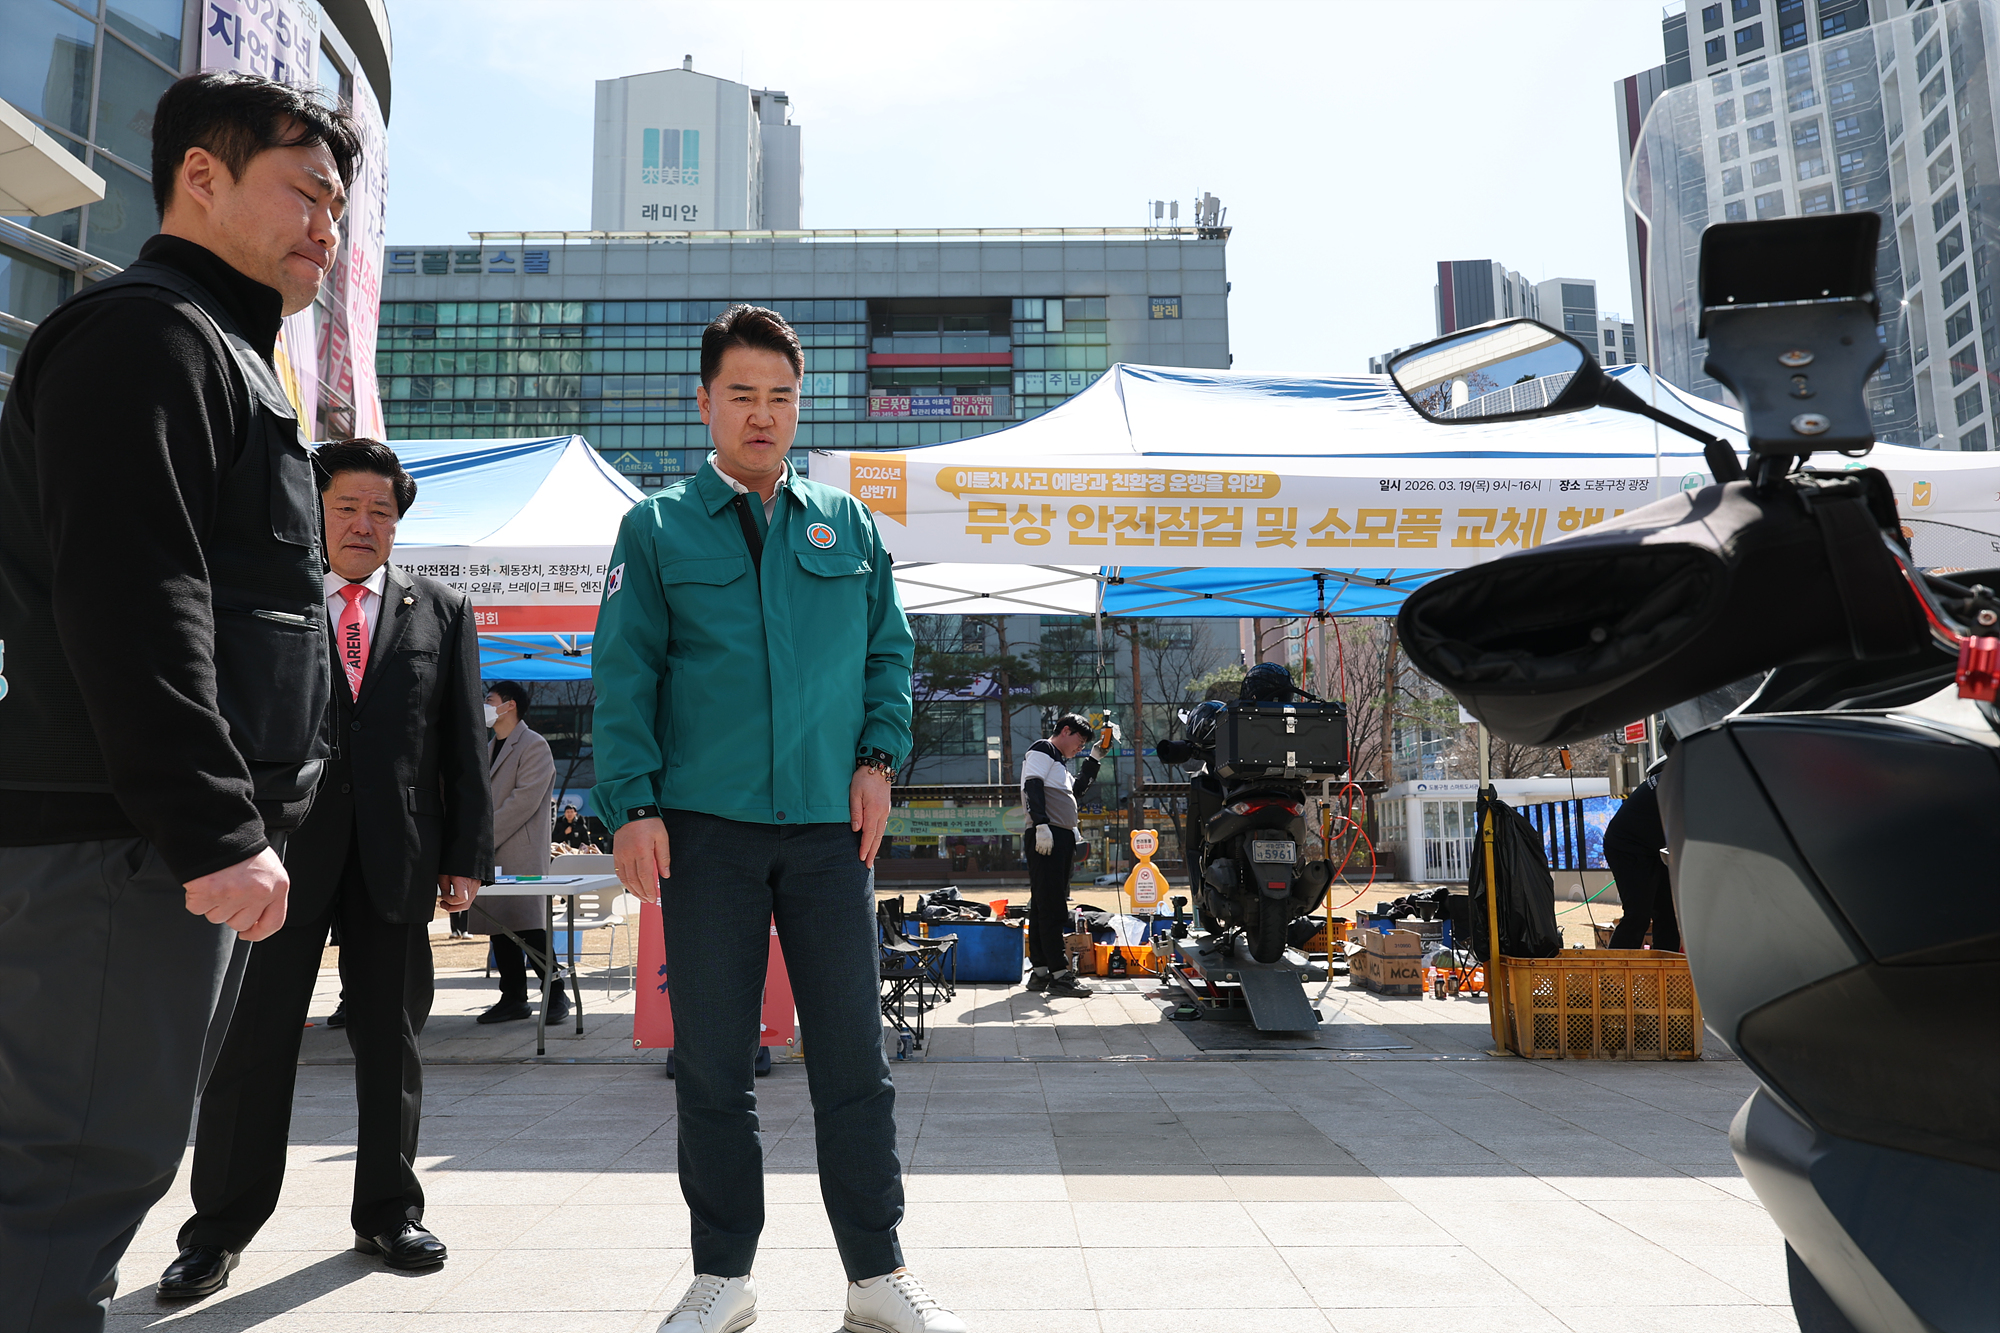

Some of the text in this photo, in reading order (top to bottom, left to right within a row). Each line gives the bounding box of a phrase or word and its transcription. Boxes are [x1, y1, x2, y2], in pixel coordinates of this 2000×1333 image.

[642, 203, 699, 222] 래미안
[1152, 304, 1178, 319] 발레
[971, 396, 993, 405] 5만원
[952, 404, 993, 416] 마사지
[855, 466, 901, 481] 2026년
[955, 471, 1266, 493] 이륜차 사고 예방과 친환경 운행을 위한
[1379, 479, 1650, 493] 일시 2026. 03. 19(목) 9시~16시 장소 도봉구청 광장
[859, 485, 897, 499] 상반기
[965, 501, 1057, 546] 무상
[1066, 504, 1244, 547] 안전점검
[1254, 506, 1298, 549] 및
[1306, 506, 1443, 549] 소모품
[1450, 507, 1548, 549] 교체
[417, 564, 460, 577] 안전점검
[469, 564, 490, 576] 등화
[499, 563, 545, 577] 제동장치,
[547, 563, 594, 577] 조향장치,
[470, 582, 505, 595] 오일류,
[507, 581, 551, 594] 브레이크
[553, 581, 578, 595] 패드,
[580, 581, 602, 593] 엔진
[345, 622, 362, 670] ARENA
[1265, 849, 1292, 860] 5961
[1390, 967, 1420, 979] MCA
